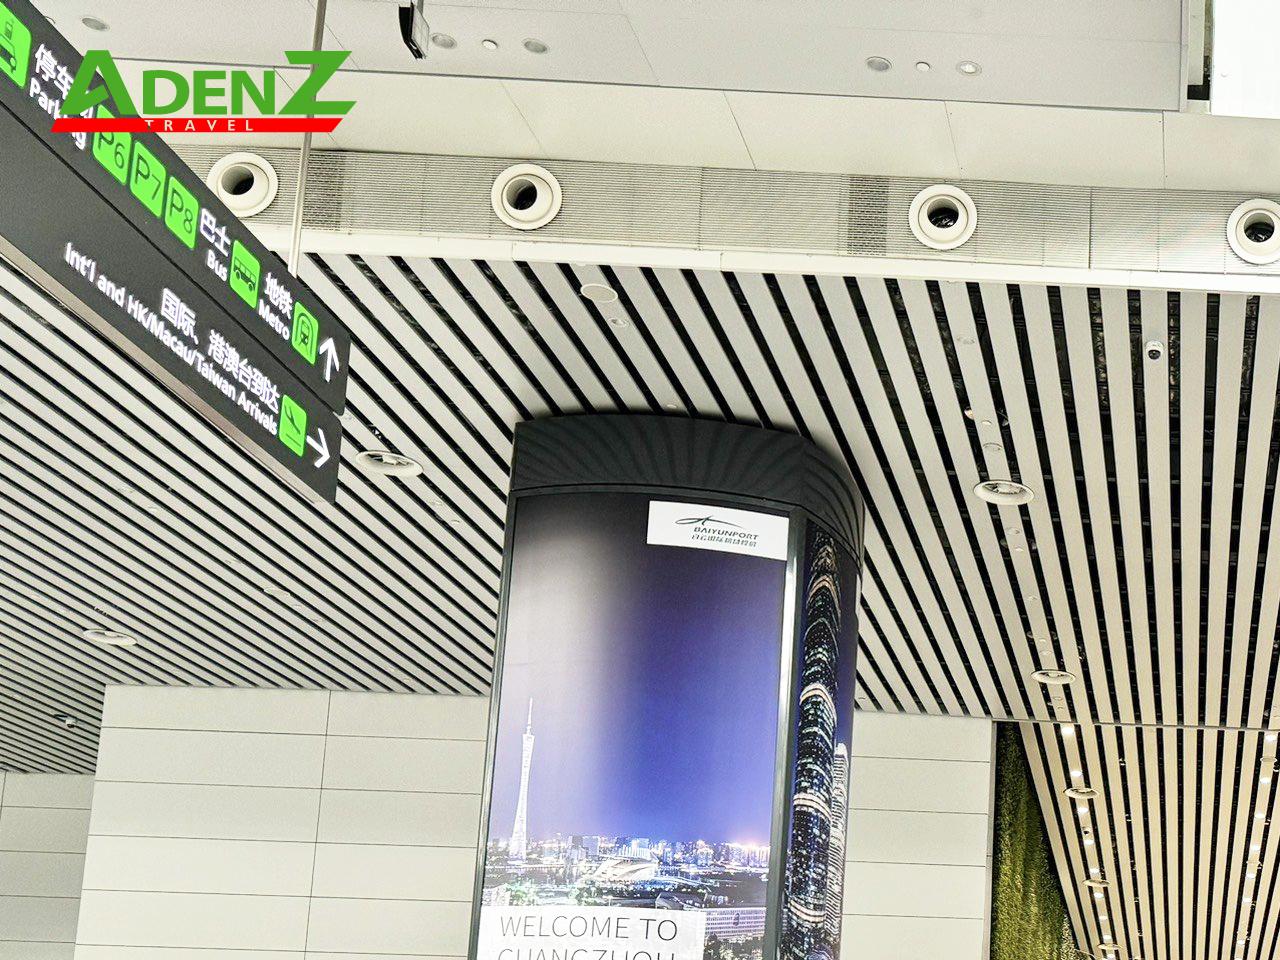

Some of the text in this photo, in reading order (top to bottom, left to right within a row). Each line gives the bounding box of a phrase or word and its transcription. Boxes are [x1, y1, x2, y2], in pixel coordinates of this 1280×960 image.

[98, 131, 125, 169] P6
[135, 156, 161, 200] P7
[170, 189, 193, 234] P8
[200, 208, 231, 257] 巴士
[207, 249, 228, 282] Bus
[264, 272, 293, 319] 地铁
[65, 242, 277, 435] Int'l and HK/Macau/Taiwan Arrivals
[258, 299, 290, 341] Metro
[694, 526, 759, 541] BAIYUNPORT
[500, 915, 677, 941] WELCOME TO
